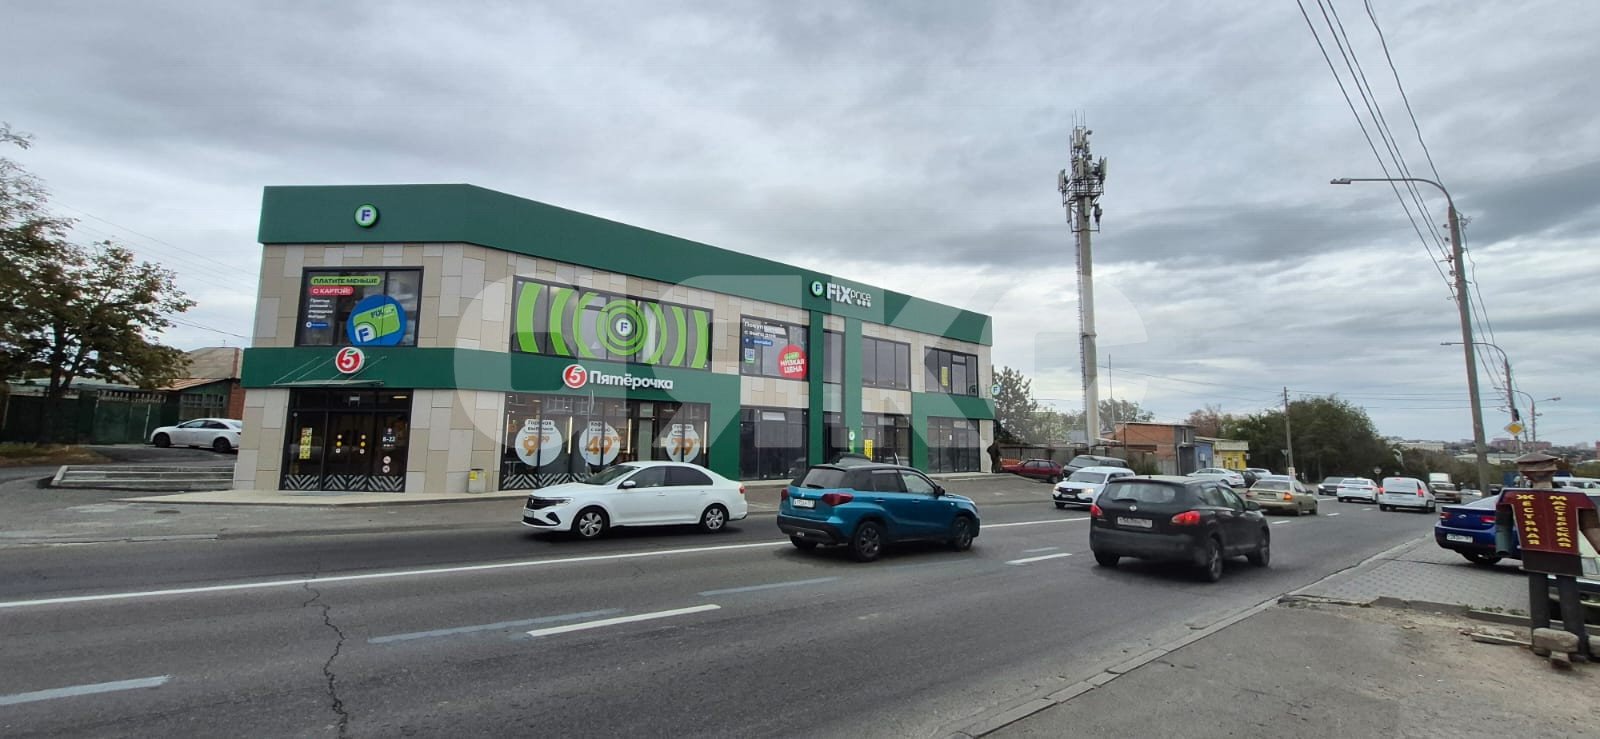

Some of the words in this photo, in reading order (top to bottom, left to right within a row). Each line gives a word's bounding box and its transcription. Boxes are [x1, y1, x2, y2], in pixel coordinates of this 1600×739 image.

[358, 328, 369, 343] F
[589, 370, 673, 390] Пятёрочка
[1549, 495, 1572, 548] МАСТЕРСКАЯ
